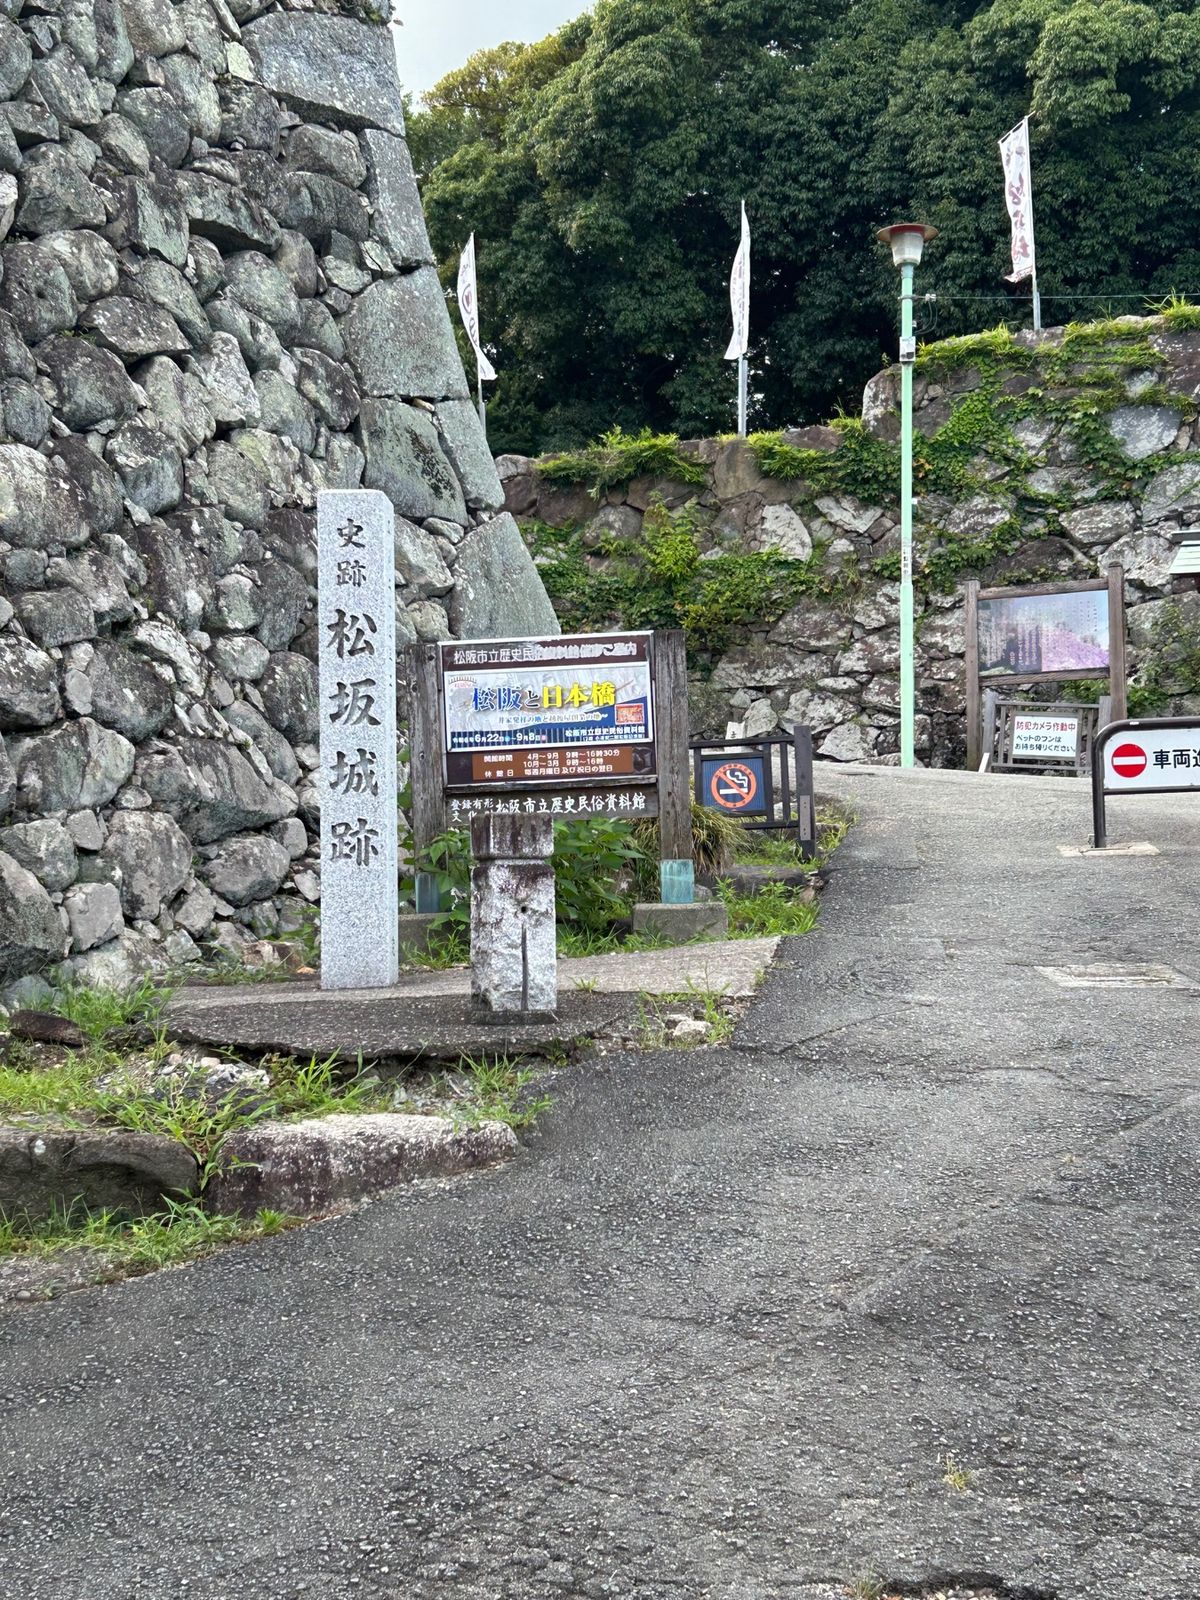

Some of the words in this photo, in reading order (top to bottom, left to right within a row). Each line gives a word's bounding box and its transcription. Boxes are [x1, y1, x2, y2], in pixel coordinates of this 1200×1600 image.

[337, 518, 366, 588] 史跡
[472, 682, 616, 711] 松阪と日本橋
[326, 608, 380, 867] 松坂城跡
[1016, 721, 1076, 731] 防犯カメラ作動中
[1016, 734, 1062, 743] ペットのフンは
[496, 792, 646, 814] 松阪市立歴史民俗資料館
